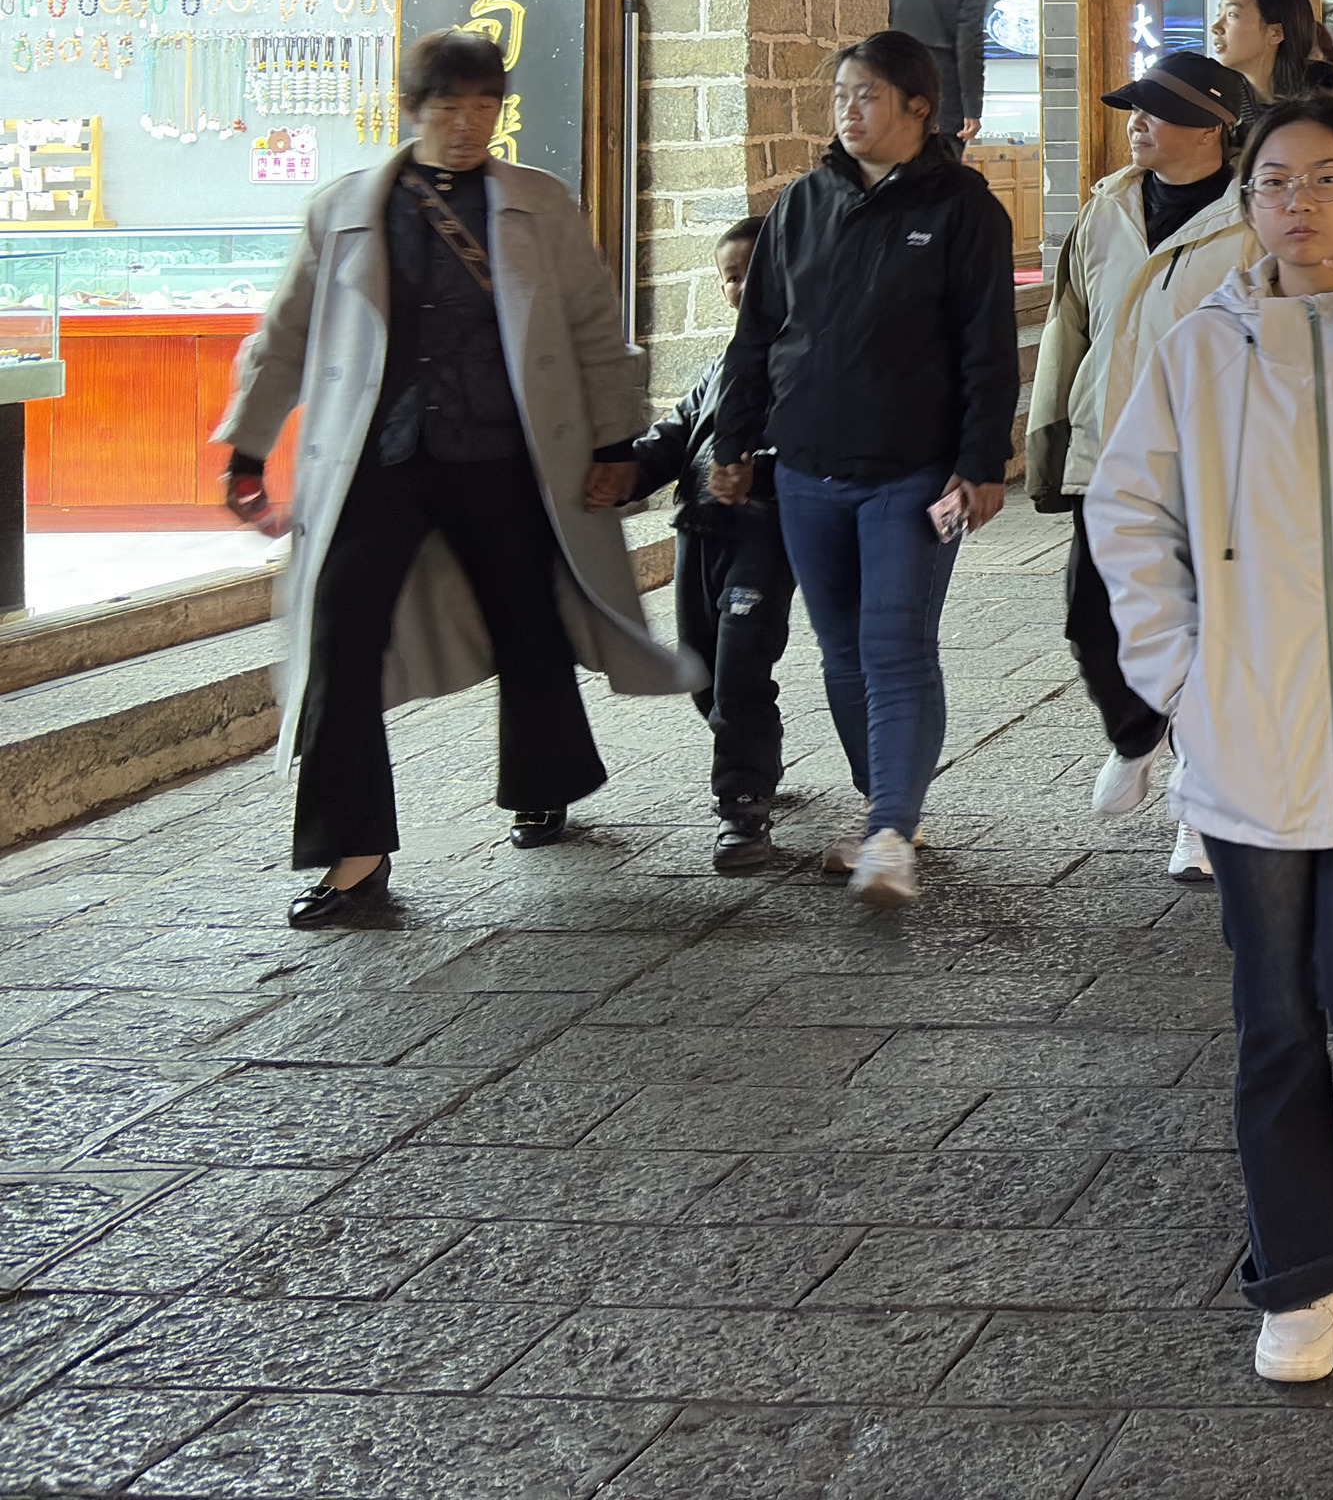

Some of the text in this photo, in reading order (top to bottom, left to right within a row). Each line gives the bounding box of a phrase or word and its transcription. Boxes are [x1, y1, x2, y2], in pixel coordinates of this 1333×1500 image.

[257, 157, 311, 168] 内有监控
[257, 168, 310, 179] 偷一罚十
